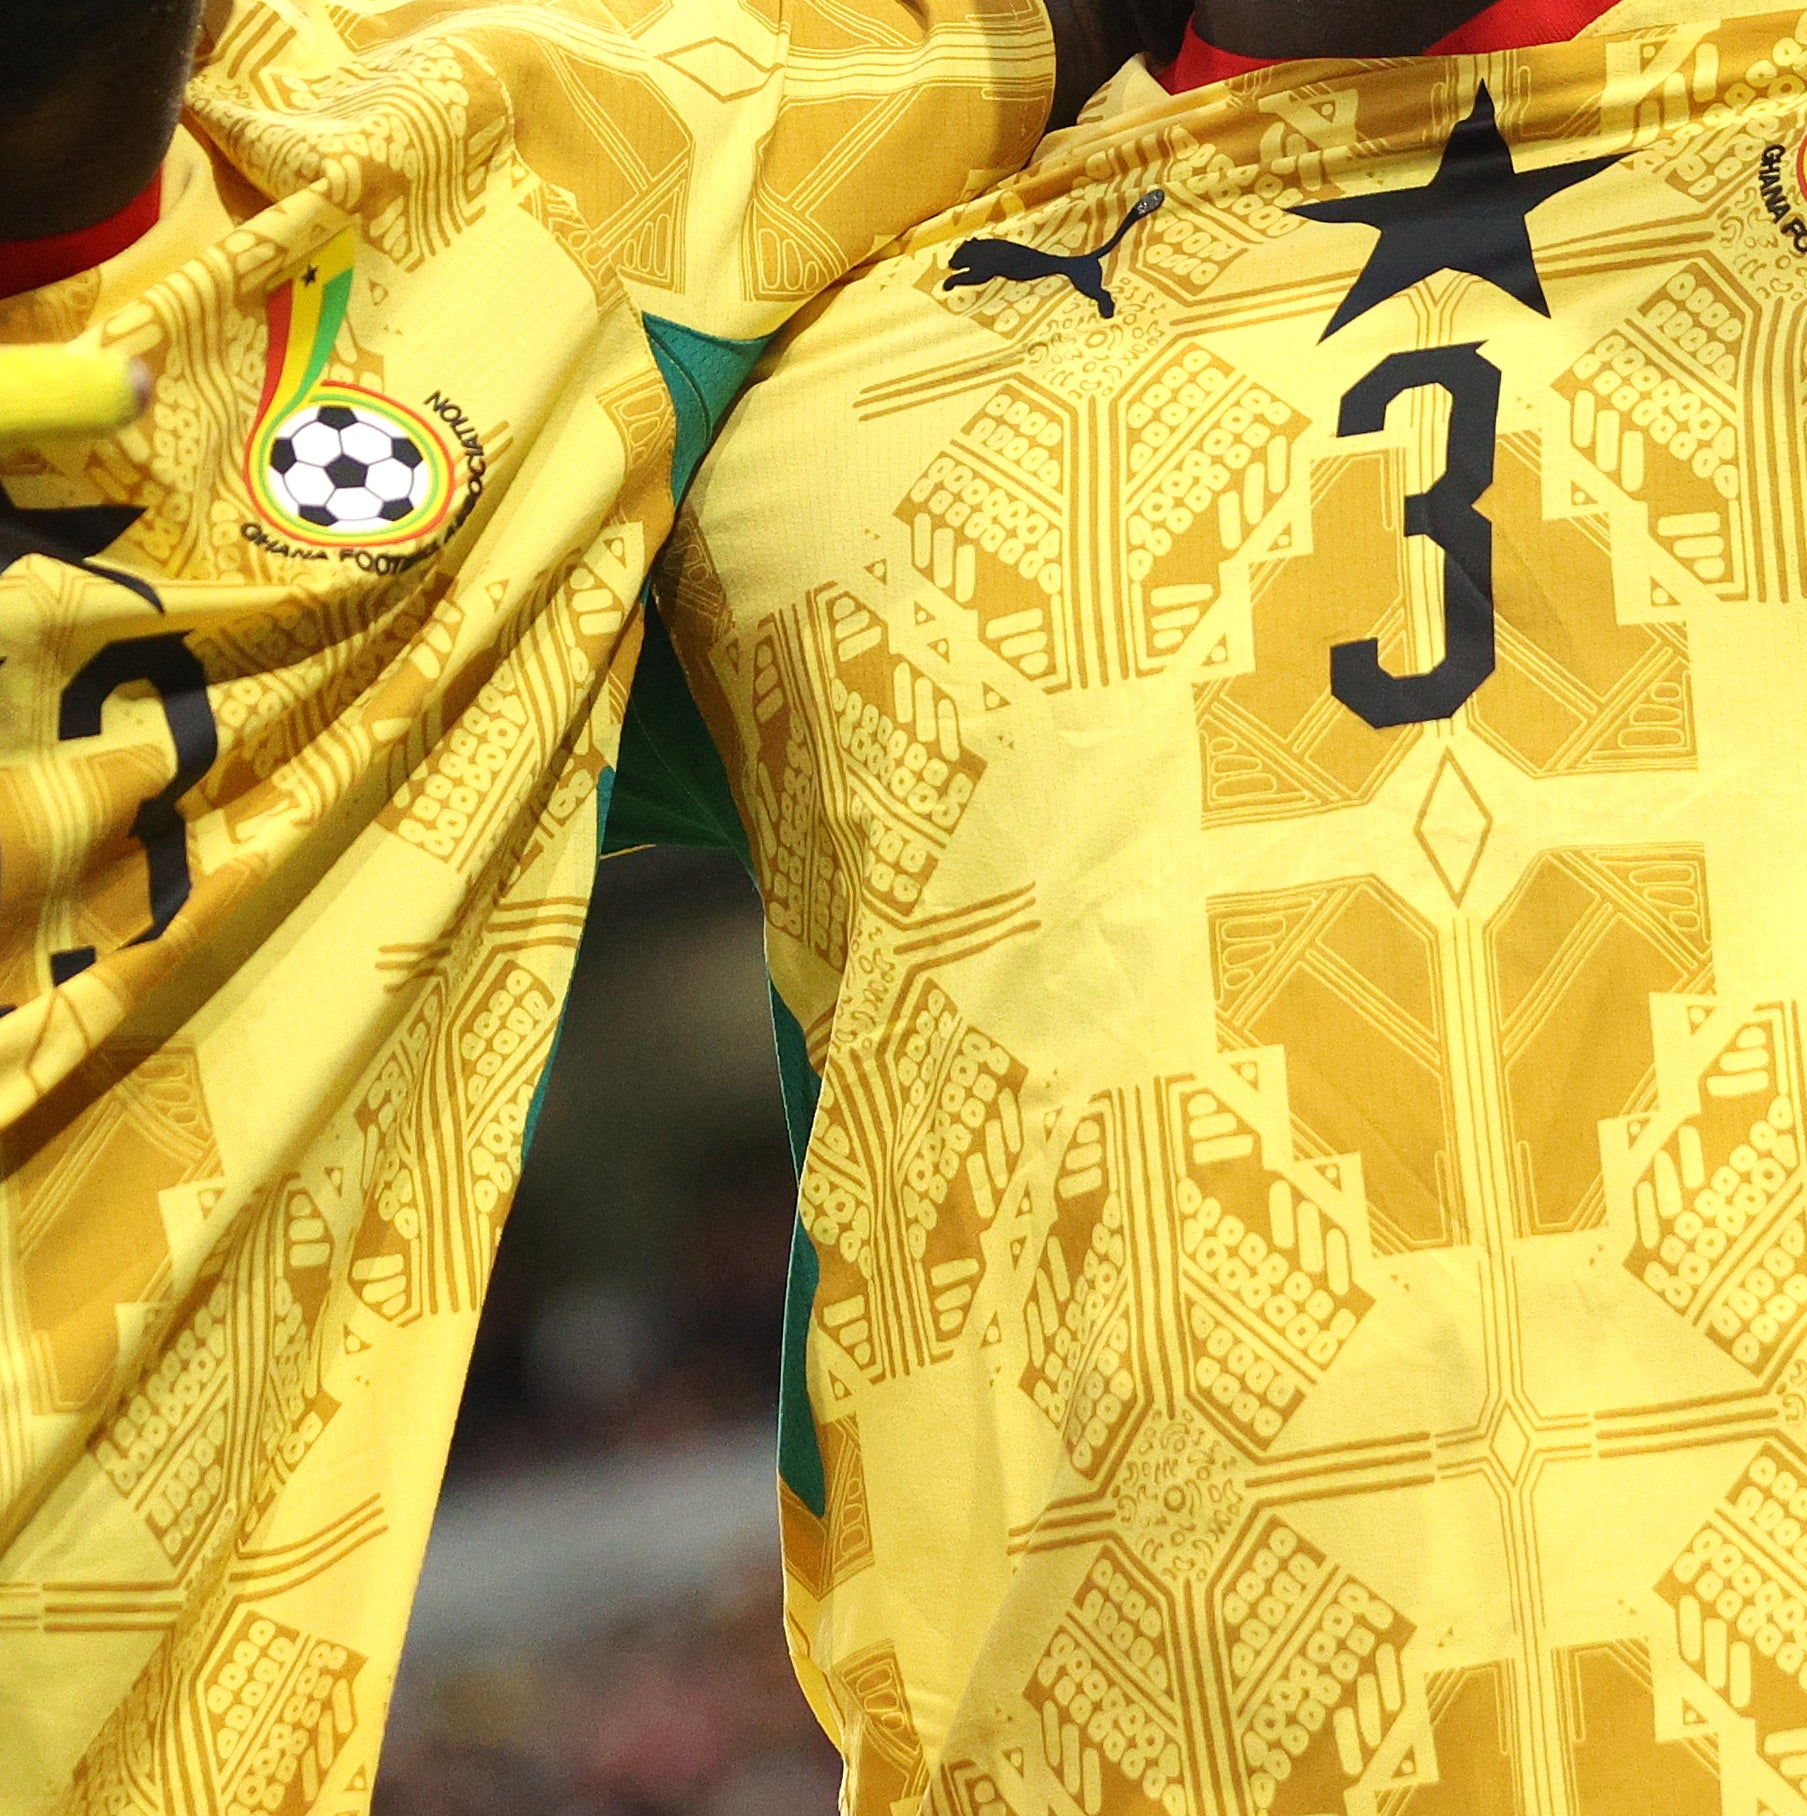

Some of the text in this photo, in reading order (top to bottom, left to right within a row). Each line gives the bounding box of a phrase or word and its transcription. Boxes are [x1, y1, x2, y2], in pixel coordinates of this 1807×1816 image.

[1758, 144, 1790, 224] GHANA
[240, 522, 329, 561] GHANA
[1329, 340, 1502, 730] 3
